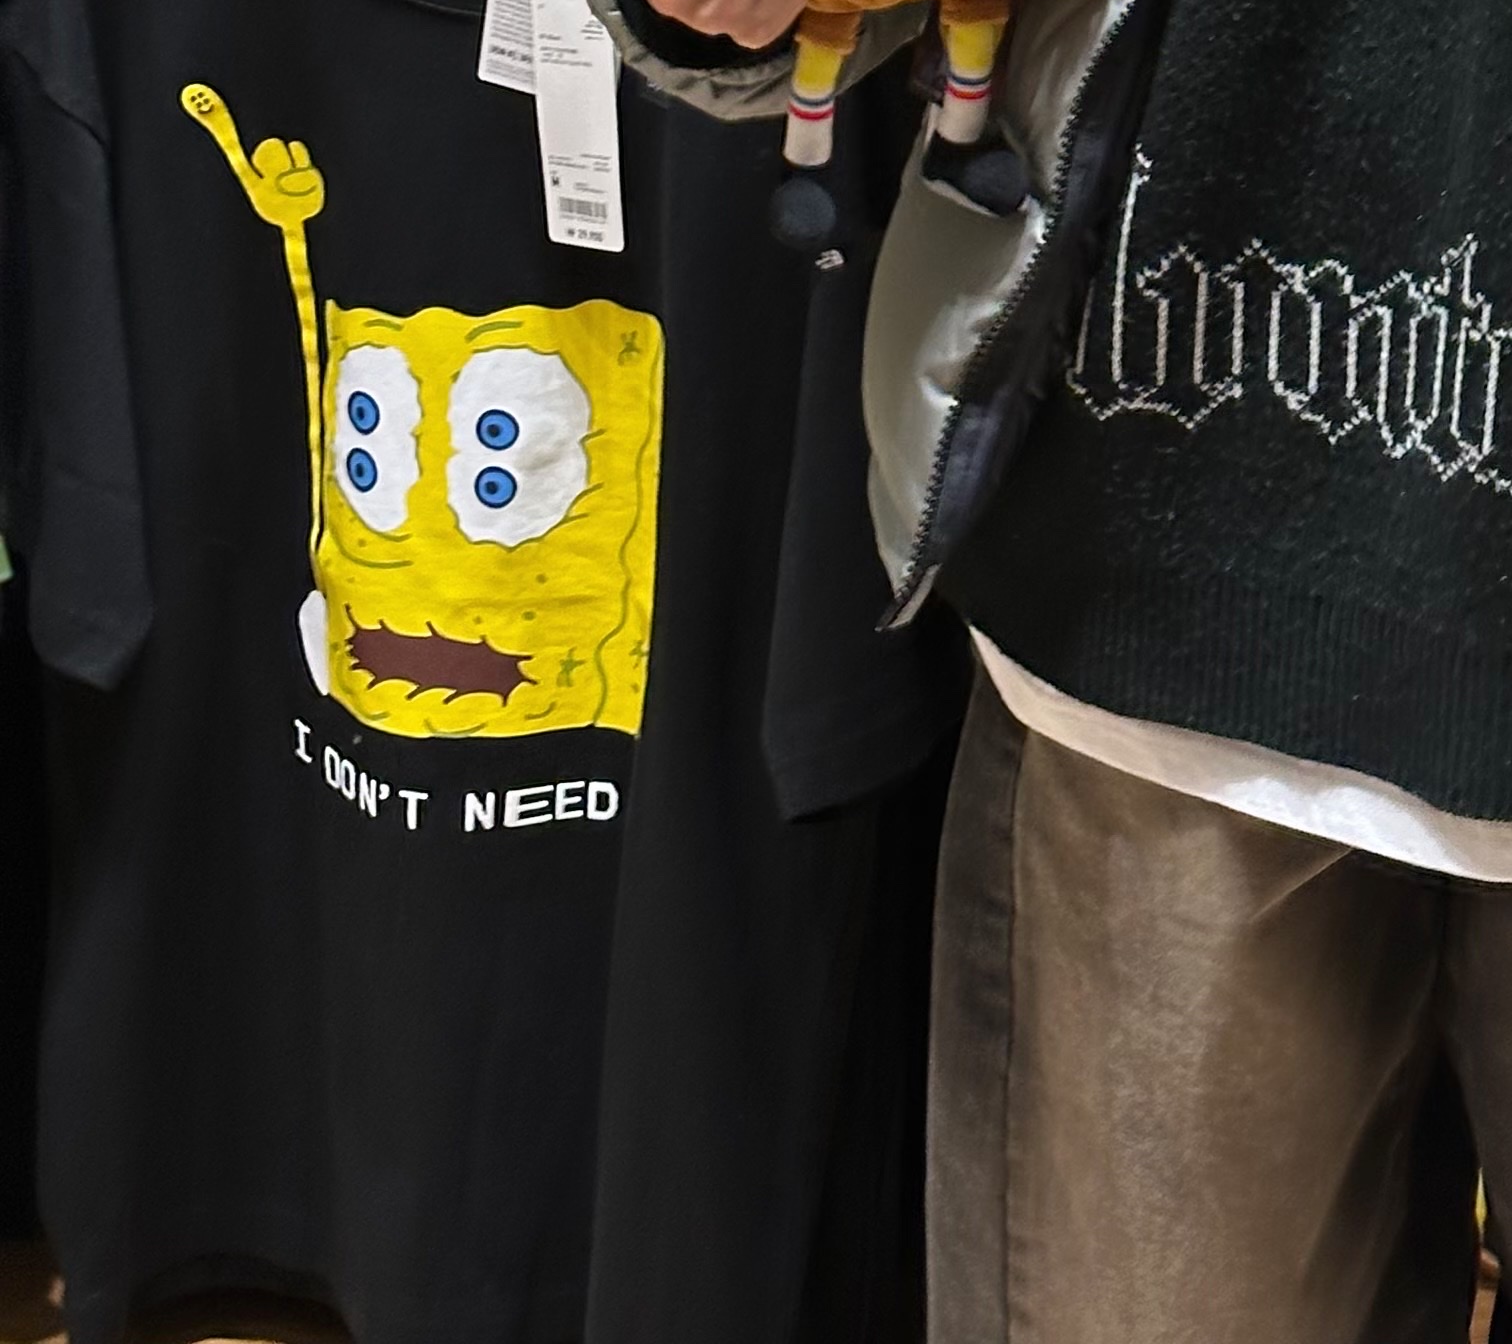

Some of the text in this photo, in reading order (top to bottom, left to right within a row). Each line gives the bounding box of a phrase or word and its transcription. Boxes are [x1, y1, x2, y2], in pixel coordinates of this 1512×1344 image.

[294, 718, 619, 832] I DON'T NEED
